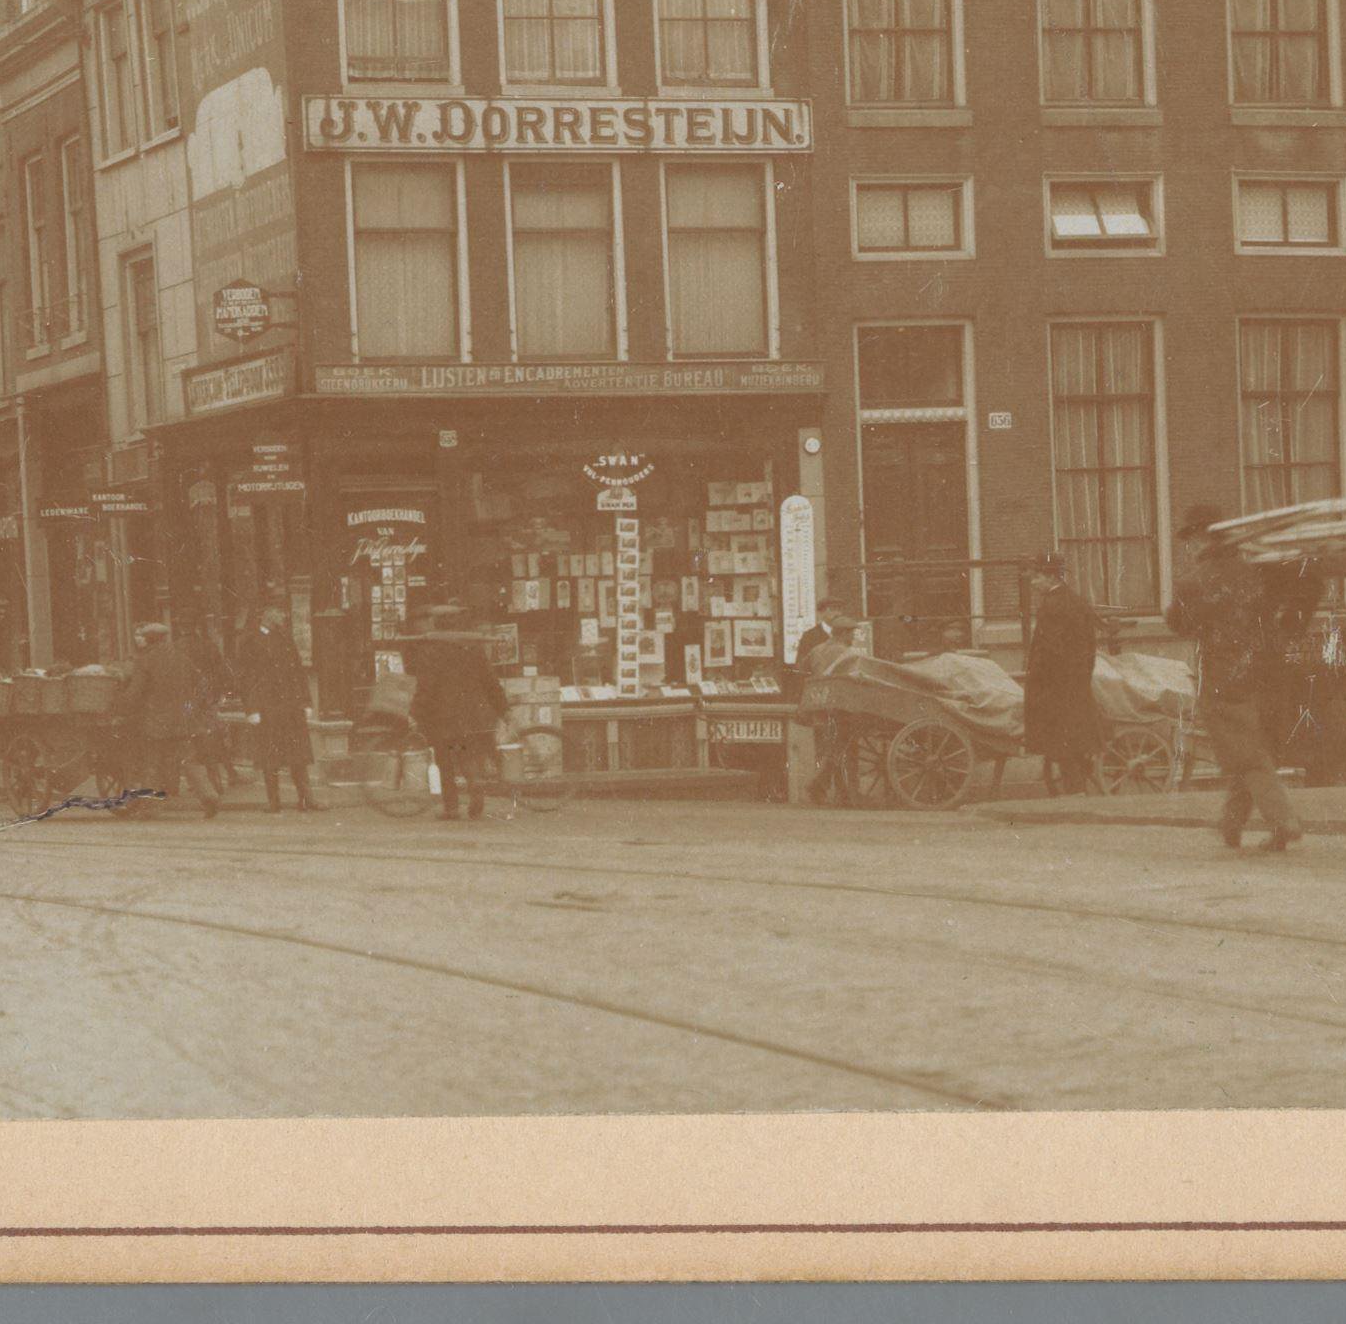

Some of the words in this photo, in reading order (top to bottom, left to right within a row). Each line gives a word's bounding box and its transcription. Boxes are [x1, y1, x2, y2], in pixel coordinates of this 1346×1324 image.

[432, 101, 806, 146] DORRESTEIJN.
[421, 366, 487, 389] LIJSTEN
[663, 368, 724, 388] BUREAU
